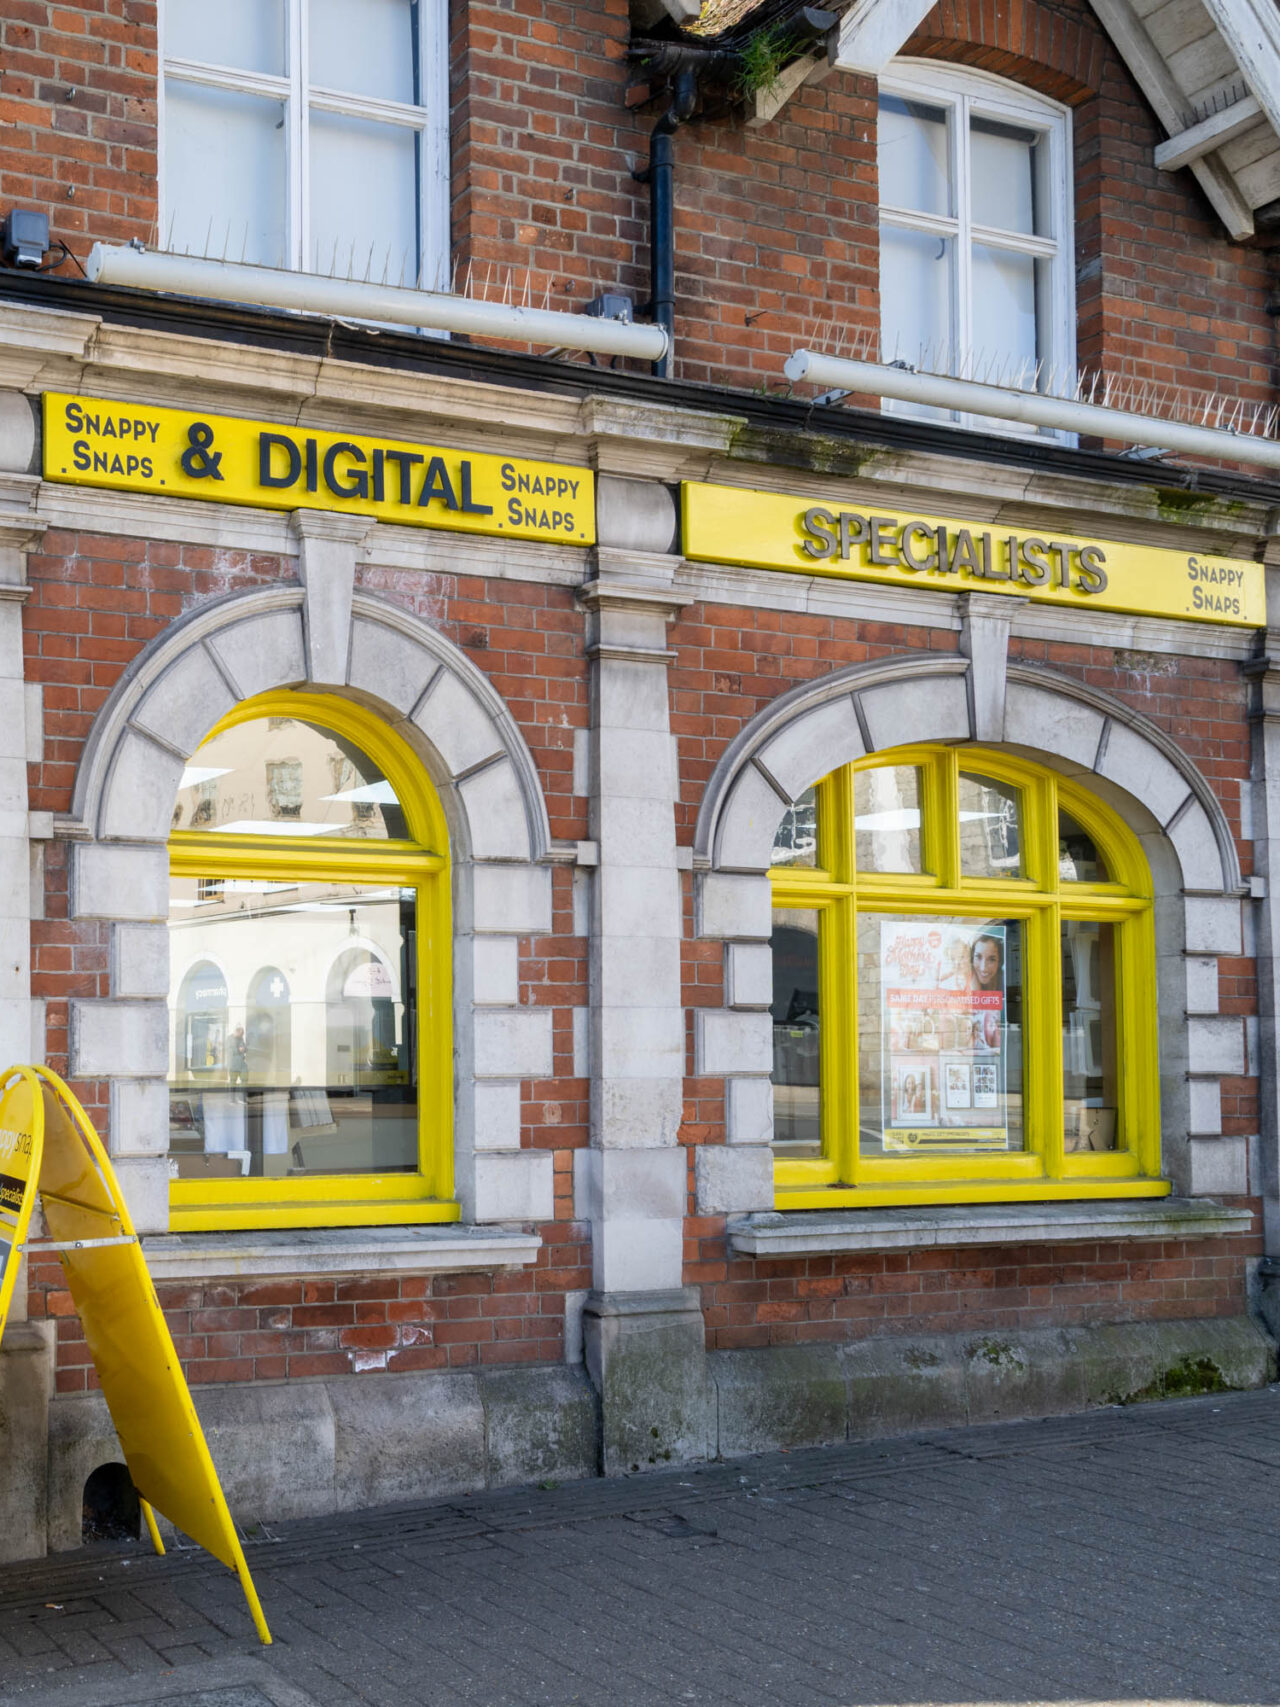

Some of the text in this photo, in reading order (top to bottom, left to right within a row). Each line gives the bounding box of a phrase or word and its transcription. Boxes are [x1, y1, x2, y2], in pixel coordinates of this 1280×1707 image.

[181, 421, 493, 515] & DIGITAL
[802, 506, 1108, 594] SPECIALISTS
[980, 996, 1000, 1006] GIFTS
